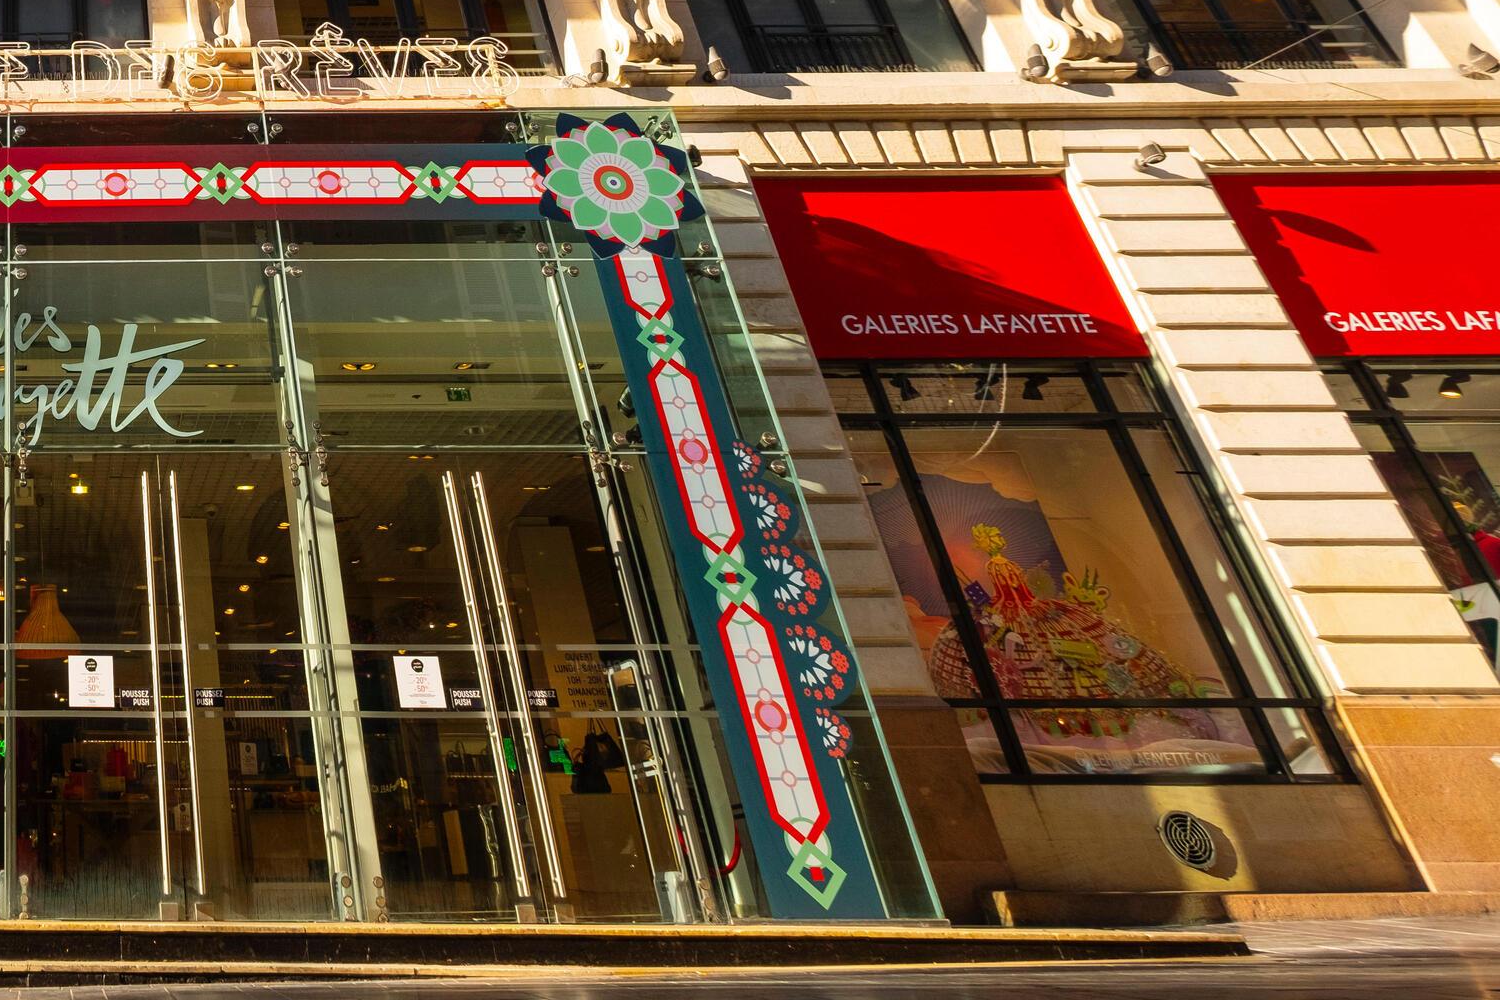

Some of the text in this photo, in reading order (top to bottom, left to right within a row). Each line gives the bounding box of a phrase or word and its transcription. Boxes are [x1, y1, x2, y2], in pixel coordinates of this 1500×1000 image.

[72, 39, 224, 101] DES
[256, 21, 521, 101] RÊVES
[841, 313, 1099, 335] GALERIES LAFAYETTE
[1324, 310, 1446, 333] GALERIES
[121, 690, 149, 698] POUSSEZ
[195, 690, 223, 698] POUSSEZ
[452, 690, 481, 698] POUSSEZ
[527, 690, 556, 698] POUSSEZ
[133, 698, 150, 706] PUSH
[196, 698, 214, 706] PUSH
[453, 698, 472, 706] PUSH
[528, 698, 547, 706] PUSH
[1074, 750, 1221, 769] GLERISLAFAYETTE.COM
